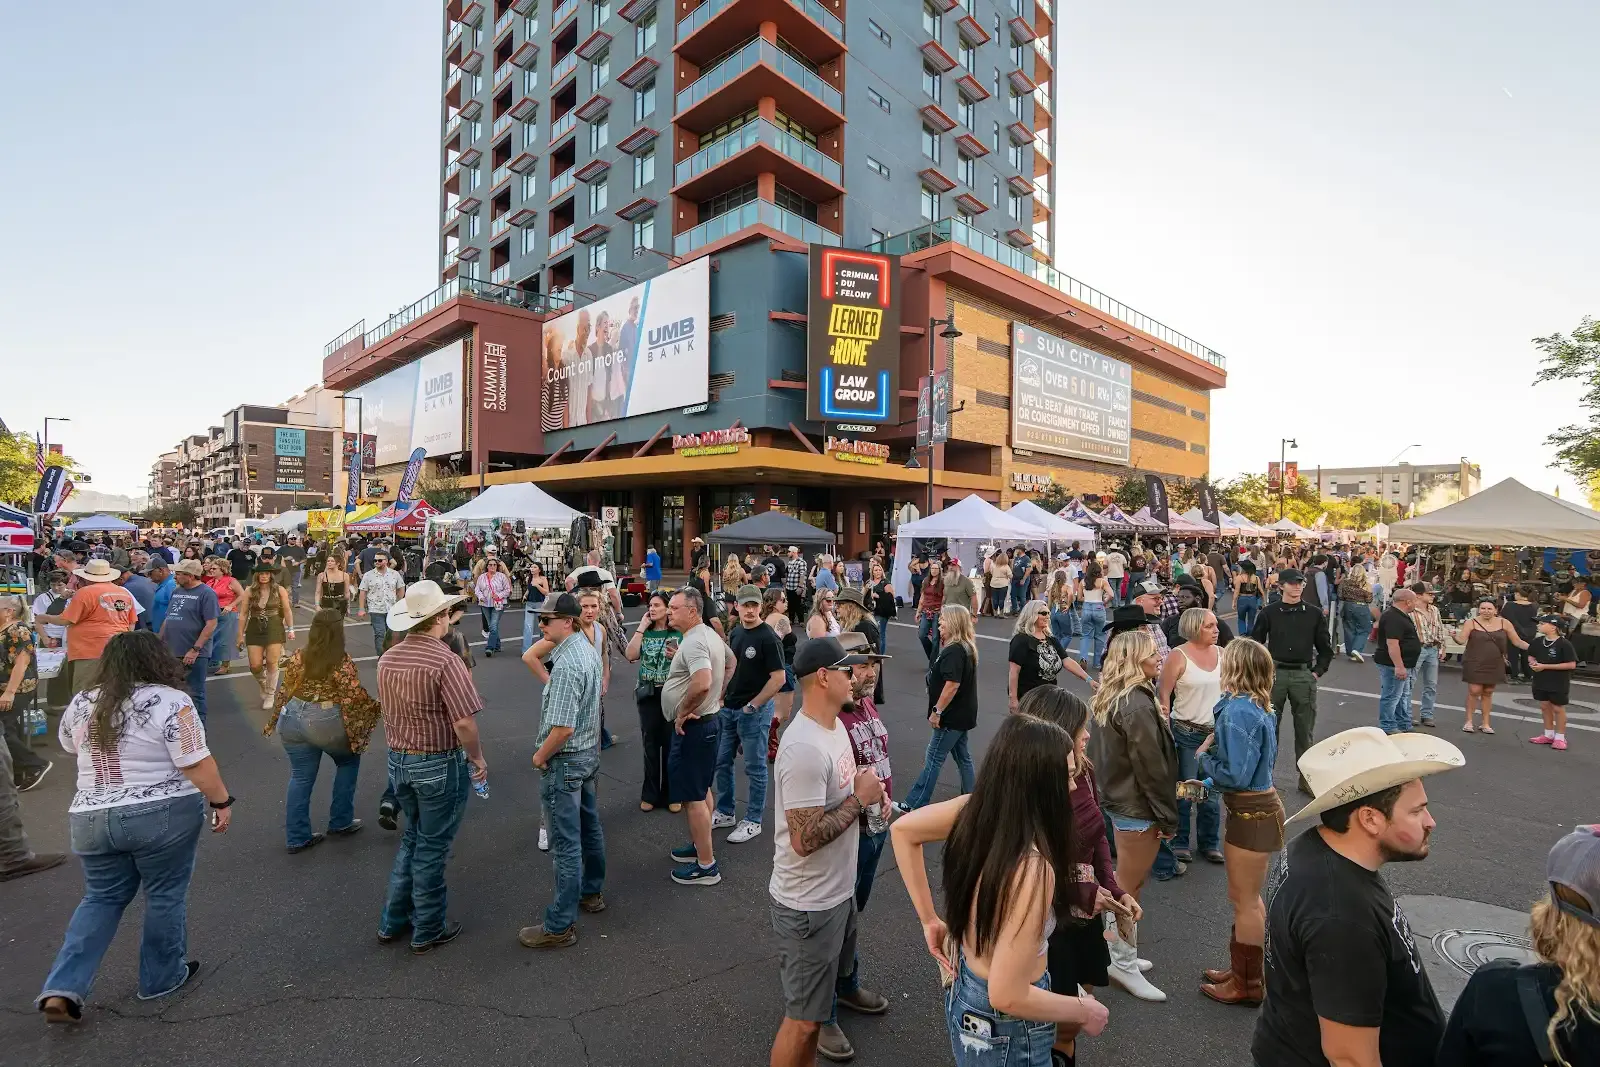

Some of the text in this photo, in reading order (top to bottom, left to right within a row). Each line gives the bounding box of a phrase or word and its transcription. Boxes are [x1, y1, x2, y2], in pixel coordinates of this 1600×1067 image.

[840, 269, 879, 282] CRIMINAL
[840, 279, 856, 288] DUI
[840, 289, 872, 300] FELONY
[648, 316, 695, 346] UMB
[832, 307, 879, 338] LERNER
[486, 342, 507, 357] THE
[647, 339, 695, 363] BANK
[833, 337, 868, 367] ROWE
[1036, 335, 1117, 376] SUN CITY RV
[547, 348, 628, 383] Count on more.
[424, 371, 454, 396] UMB
[484, 354, 498, 411] SUMMIT
[498, 356, 508, 411] CONDOMINIUMS
[839, 374, 869, 389] LAW
[1045, 369, 1069, 390] OVER
[424, 396, 454, 413] BANK
[834, 388, 876, 403] GROUP
[684, 404, 707, 414] LAMAR
[1020, 392, 1099, 423] WE'LL BEAT ANY TRADE
[839, 424, 874, 432] LAMAR
[1018, 406, 1100, 436] OR CONSIGNMENT OFFER
[1108, 415, 1127, 429] FAMILY
[1107, 427, 1127, 441] OWNED
